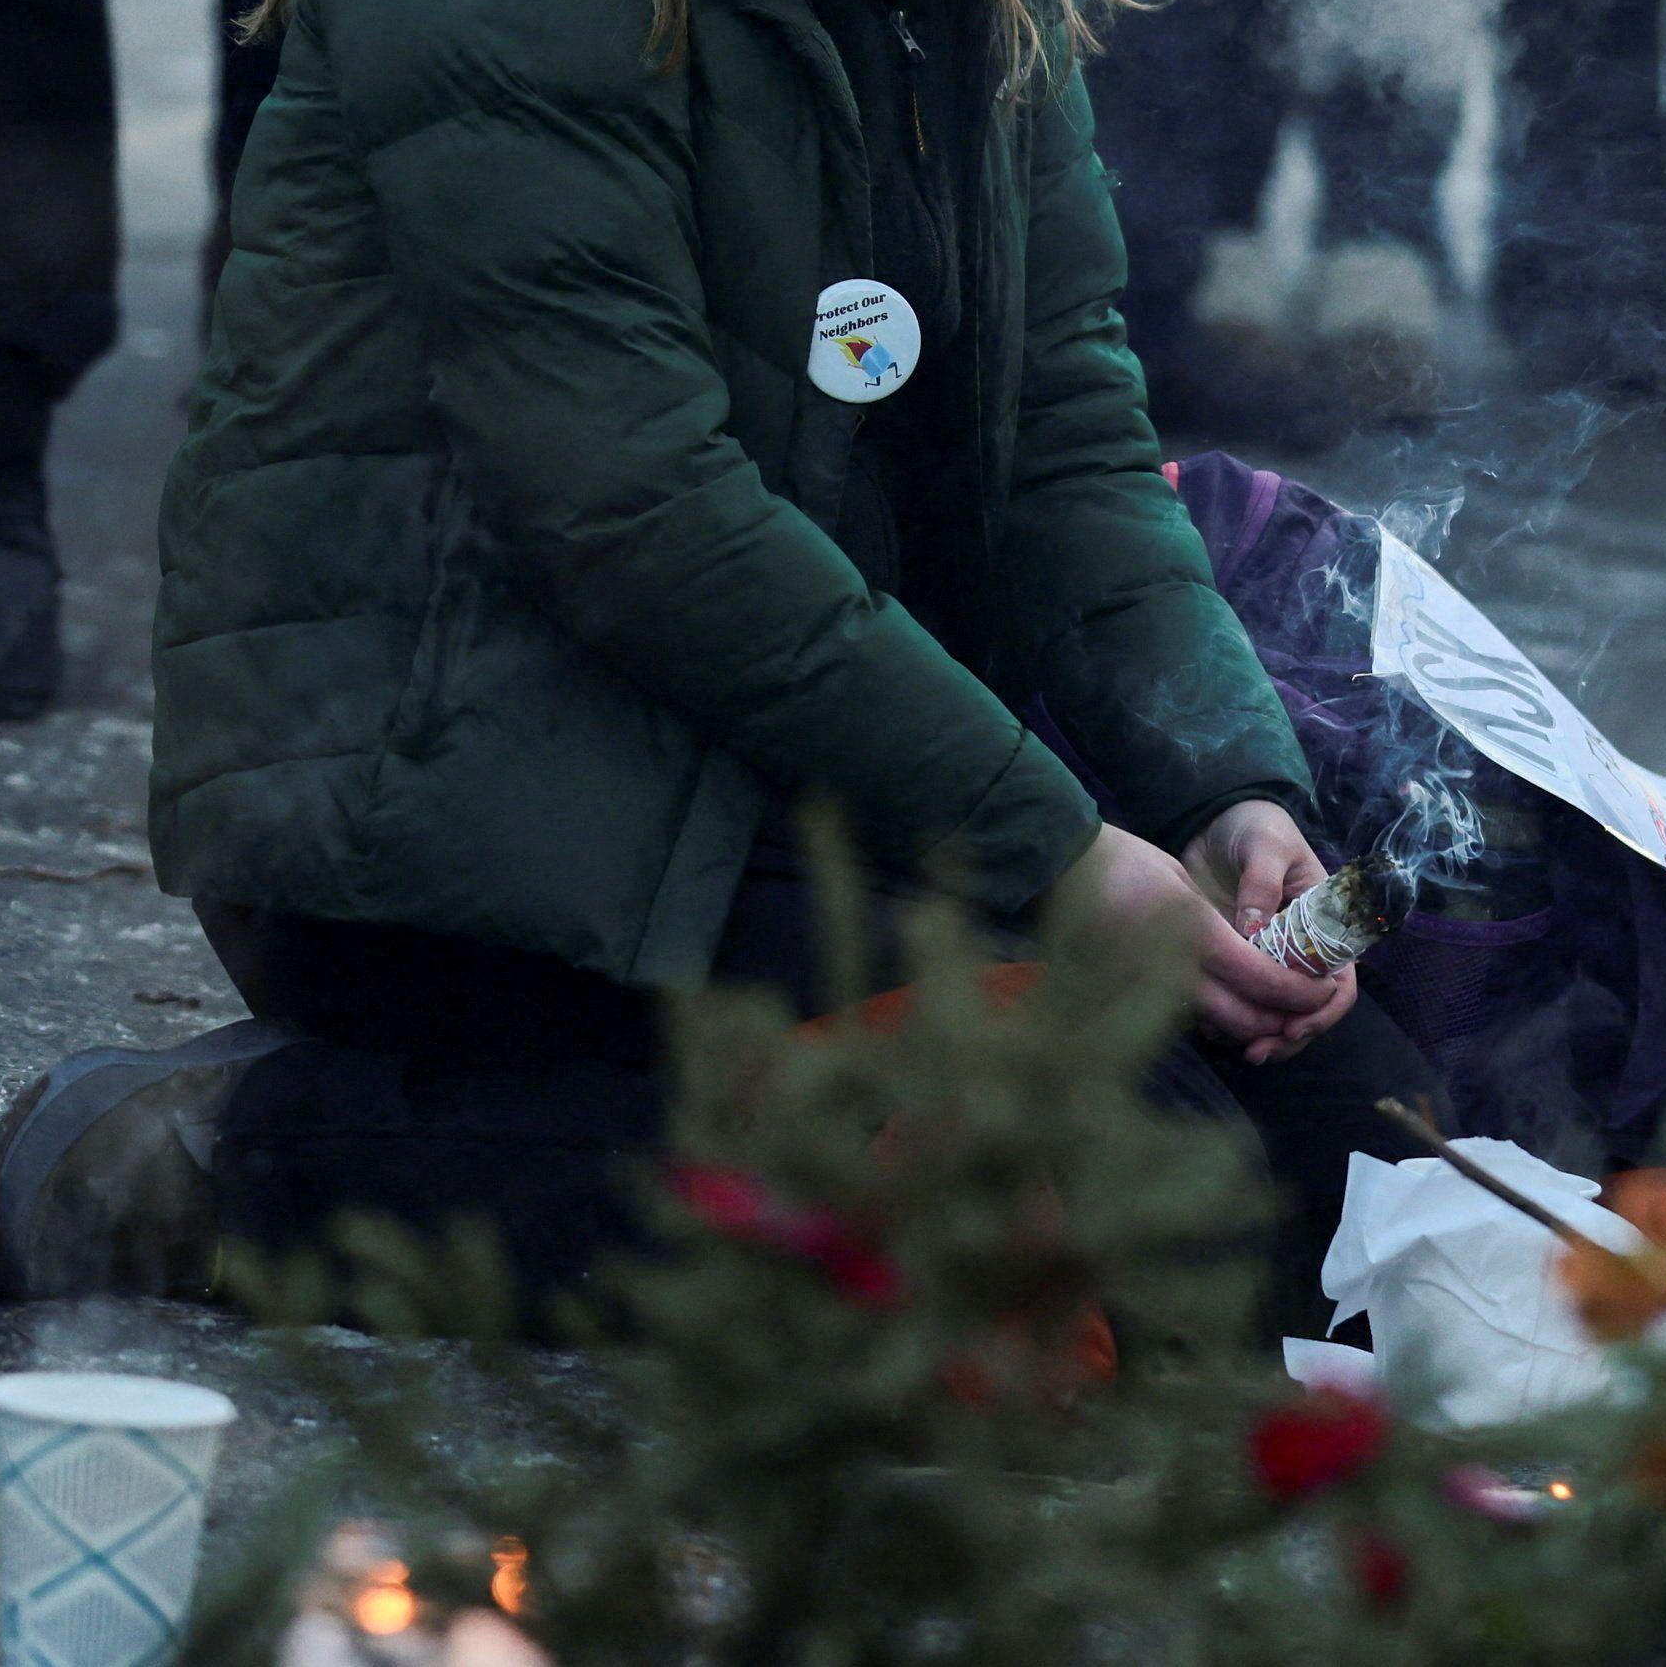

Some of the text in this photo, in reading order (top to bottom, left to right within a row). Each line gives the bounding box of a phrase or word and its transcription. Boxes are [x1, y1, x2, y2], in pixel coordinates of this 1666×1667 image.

[813, 294, 886, 322] rotect Our
[819, 312, 889, 341] Neighbors
